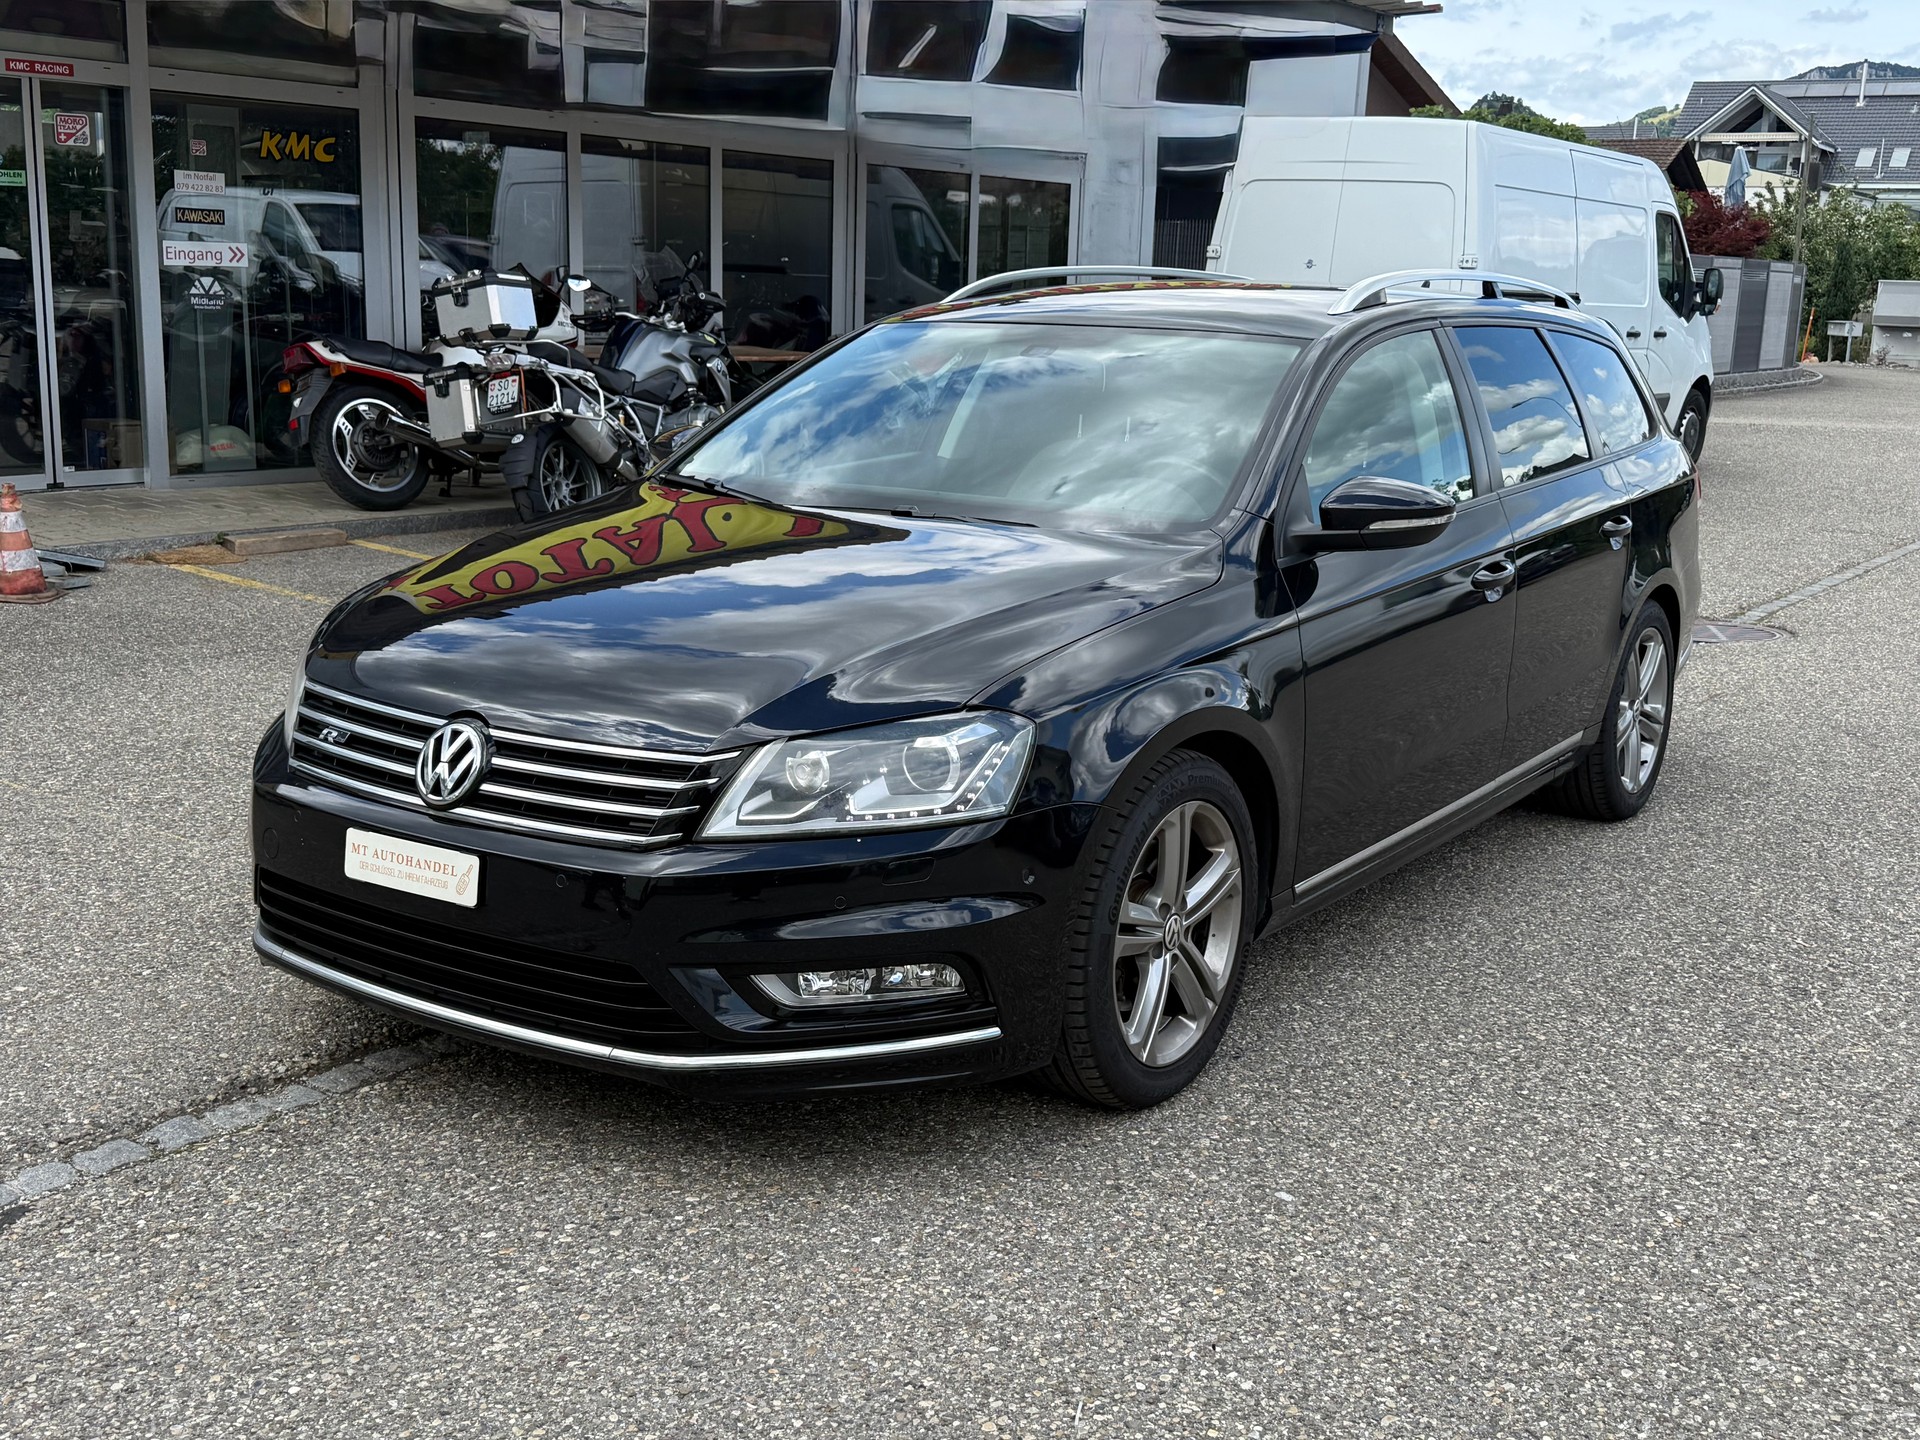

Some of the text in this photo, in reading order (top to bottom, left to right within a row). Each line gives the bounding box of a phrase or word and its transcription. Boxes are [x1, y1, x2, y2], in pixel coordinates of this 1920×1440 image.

[9, 60, 70, 74] KMC RACING
[59, 117, 85, 126] MOKO
[260, 130, 336, 163] KMC
[182, 172, 217, 182] Im Notfall
[175, 182, 224, 193] 079 422 82 83
[176, 209, 224, 223] KAWASAKI
[165, 246, 223, 265] Eingang
[497, 379, 510, 392] SO
[351, 842, 458, 877] MT AUTOHANDEL
